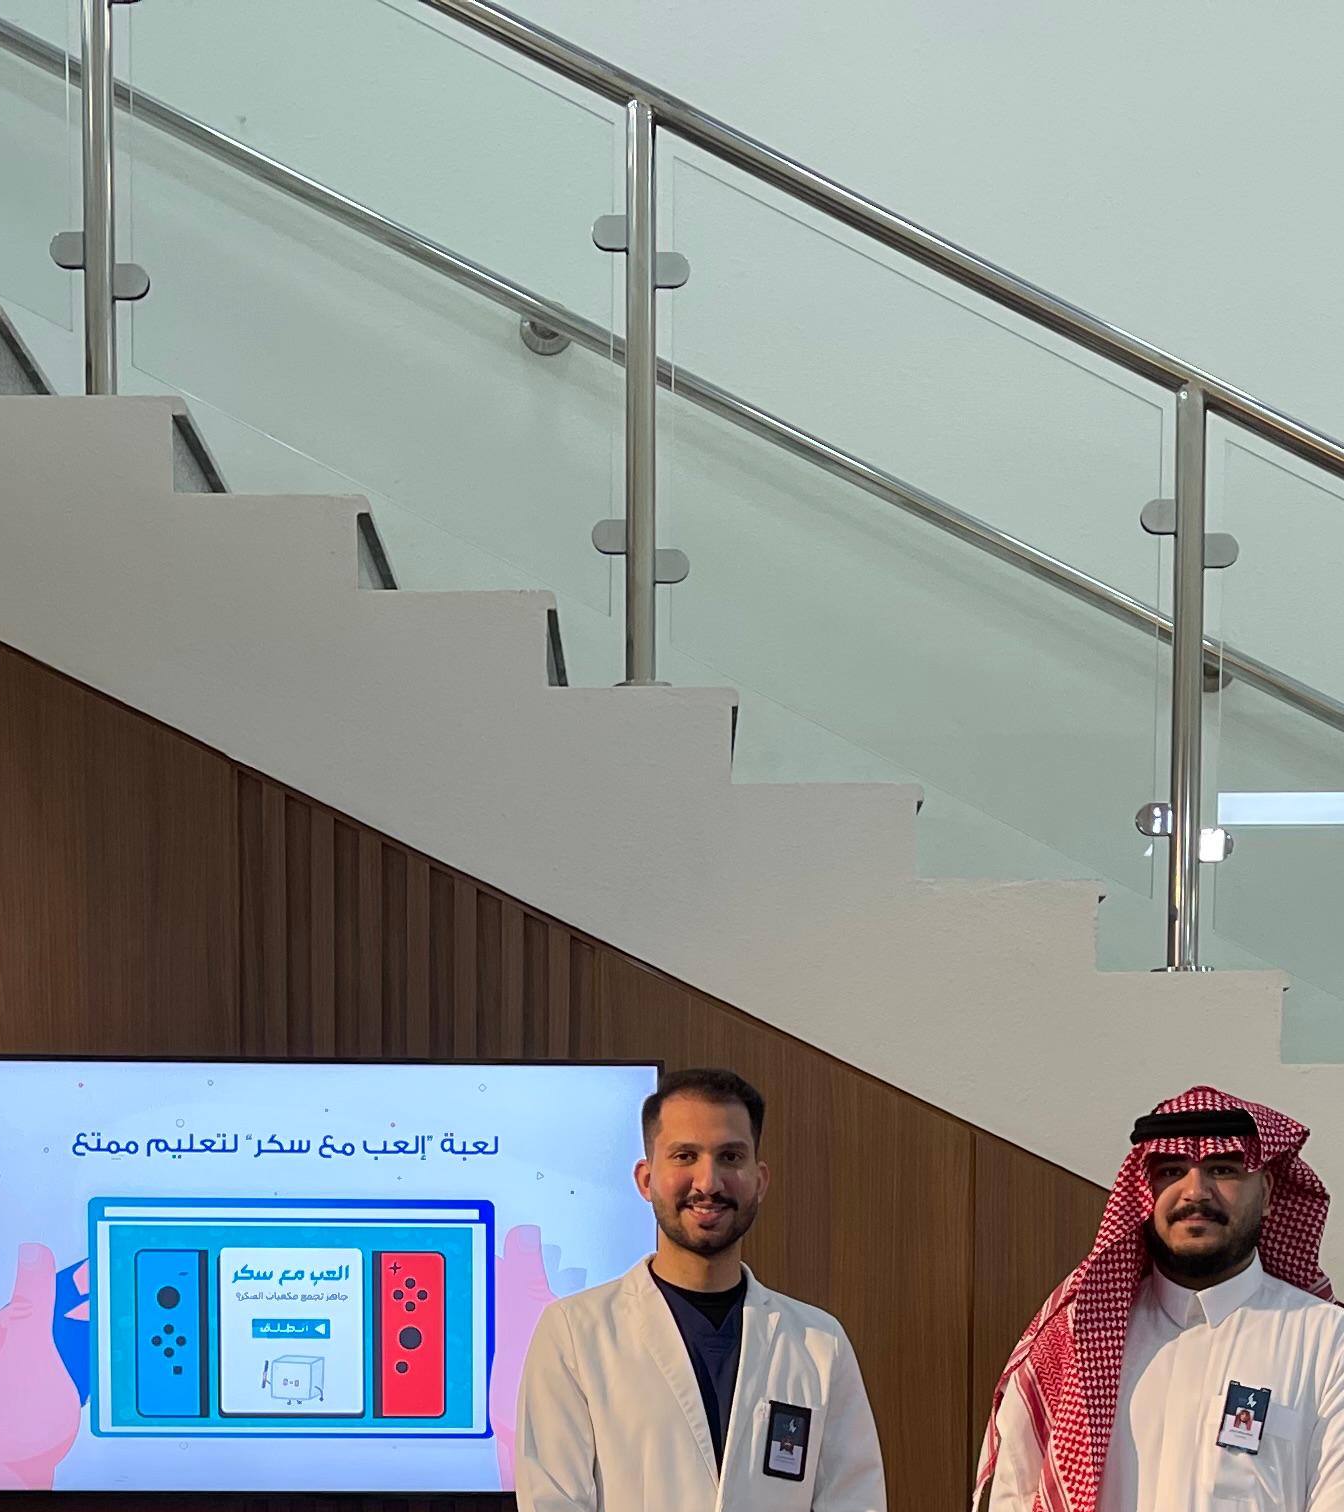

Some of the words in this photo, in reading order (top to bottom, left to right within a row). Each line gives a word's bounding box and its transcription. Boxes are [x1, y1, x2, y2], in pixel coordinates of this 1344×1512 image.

[72, 1132, 138, 1156] ممتع
[147, 1134, 238, 1159] لتعليم
[319, 1135, 355, 1158] مع
[441, 1133, 498, 1161] لعبة
[232, 1264, 273, 1283] سكر
[279, 1270, 304, 1286] مع
[310, 1265, 349, 1286] العب
